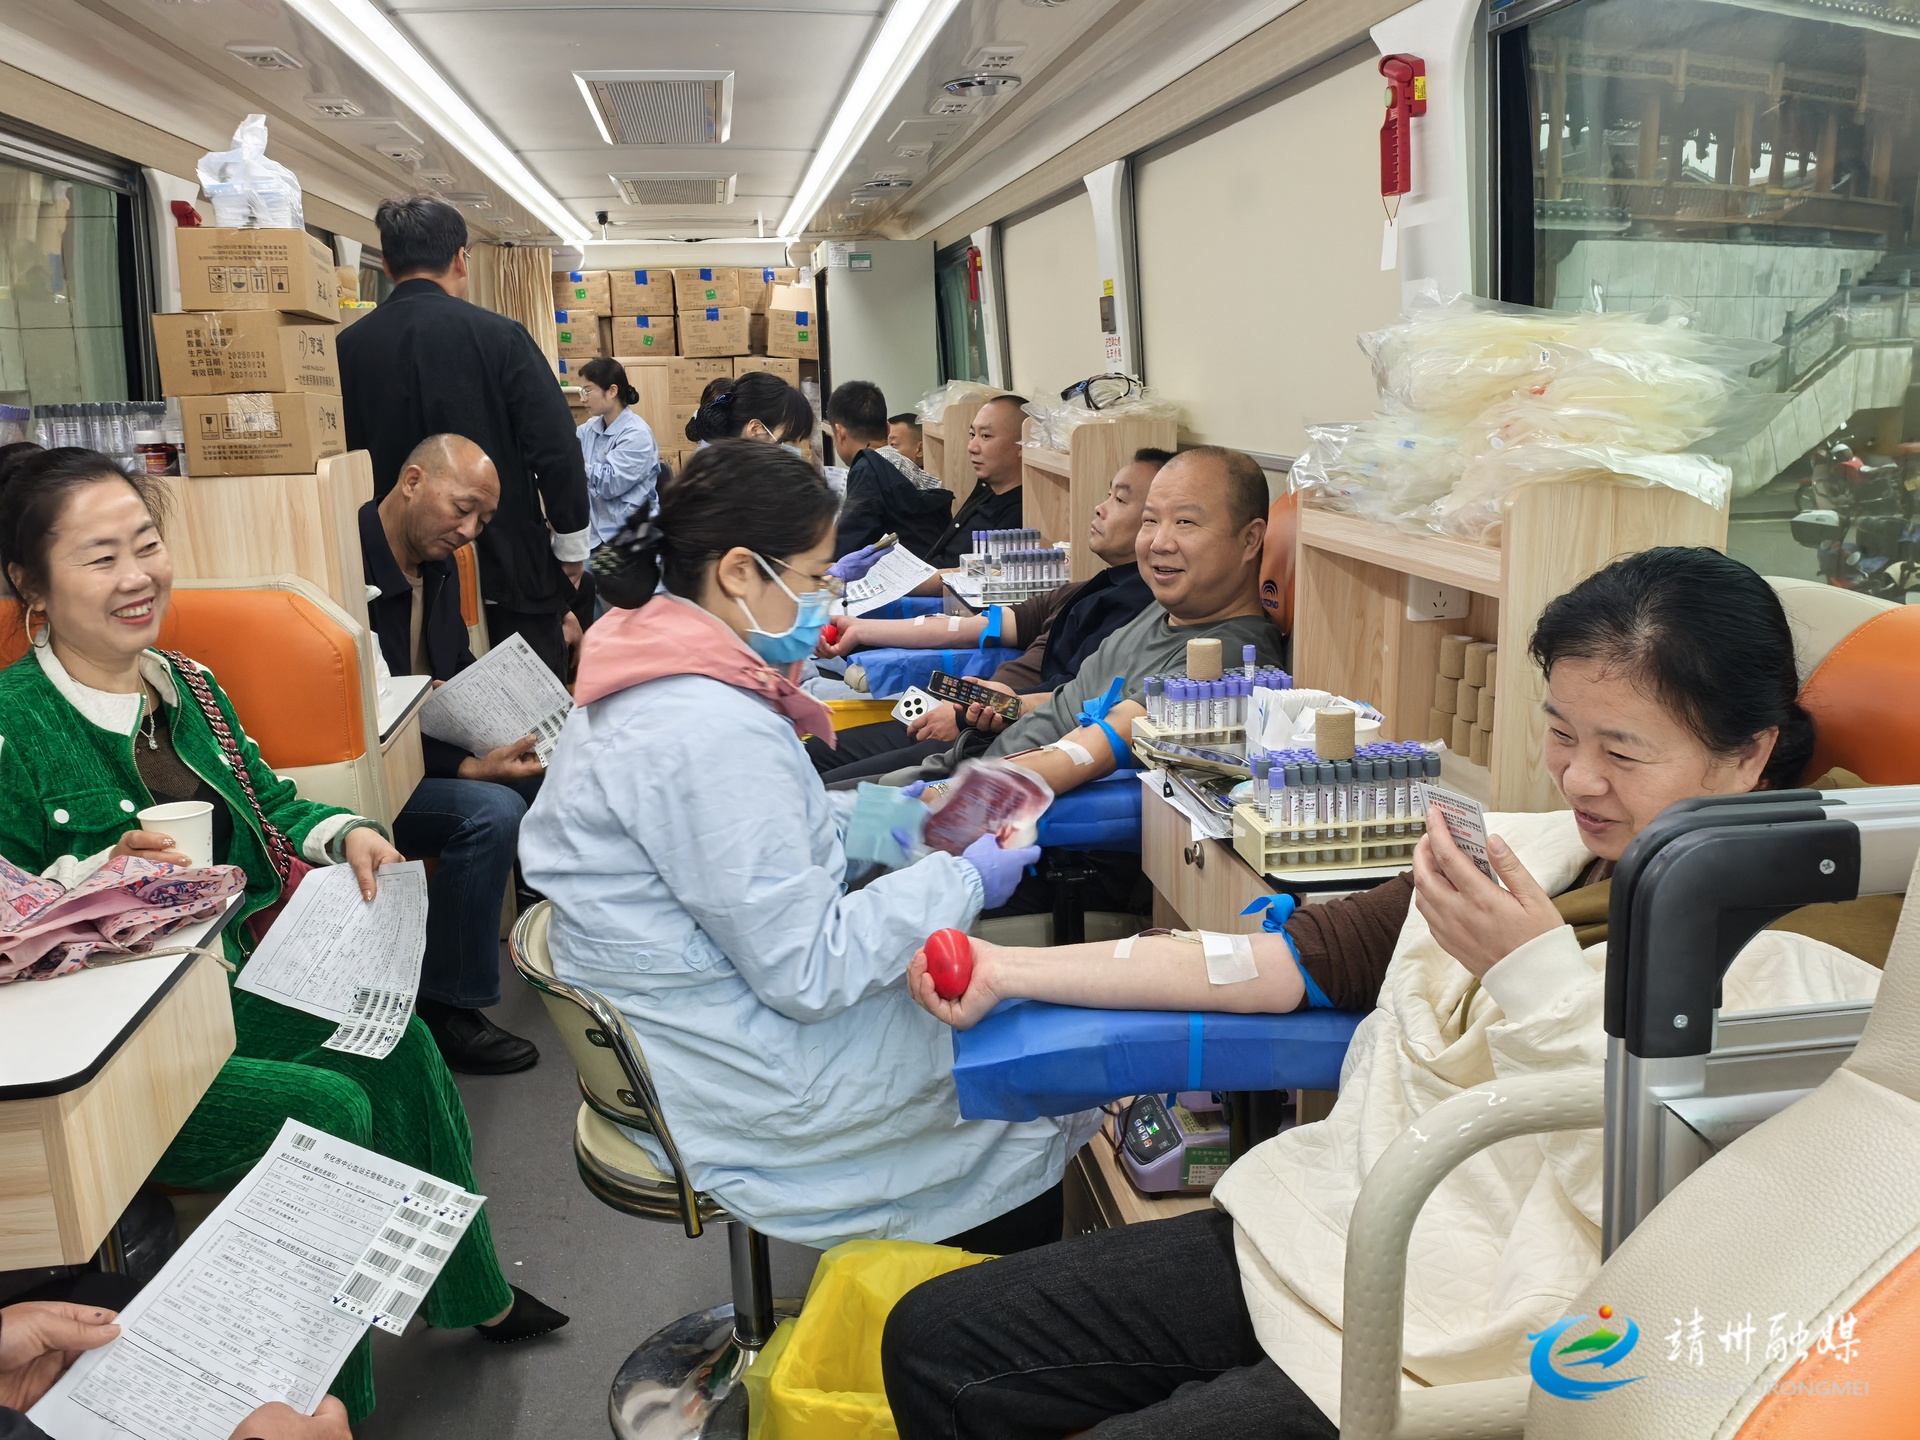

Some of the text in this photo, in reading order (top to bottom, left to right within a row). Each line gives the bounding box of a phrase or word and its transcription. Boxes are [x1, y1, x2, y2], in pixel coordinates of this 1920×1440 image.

[190, 358, 224, 367] 生产日期：
[191, 368, 225, 377] 有效日期：
